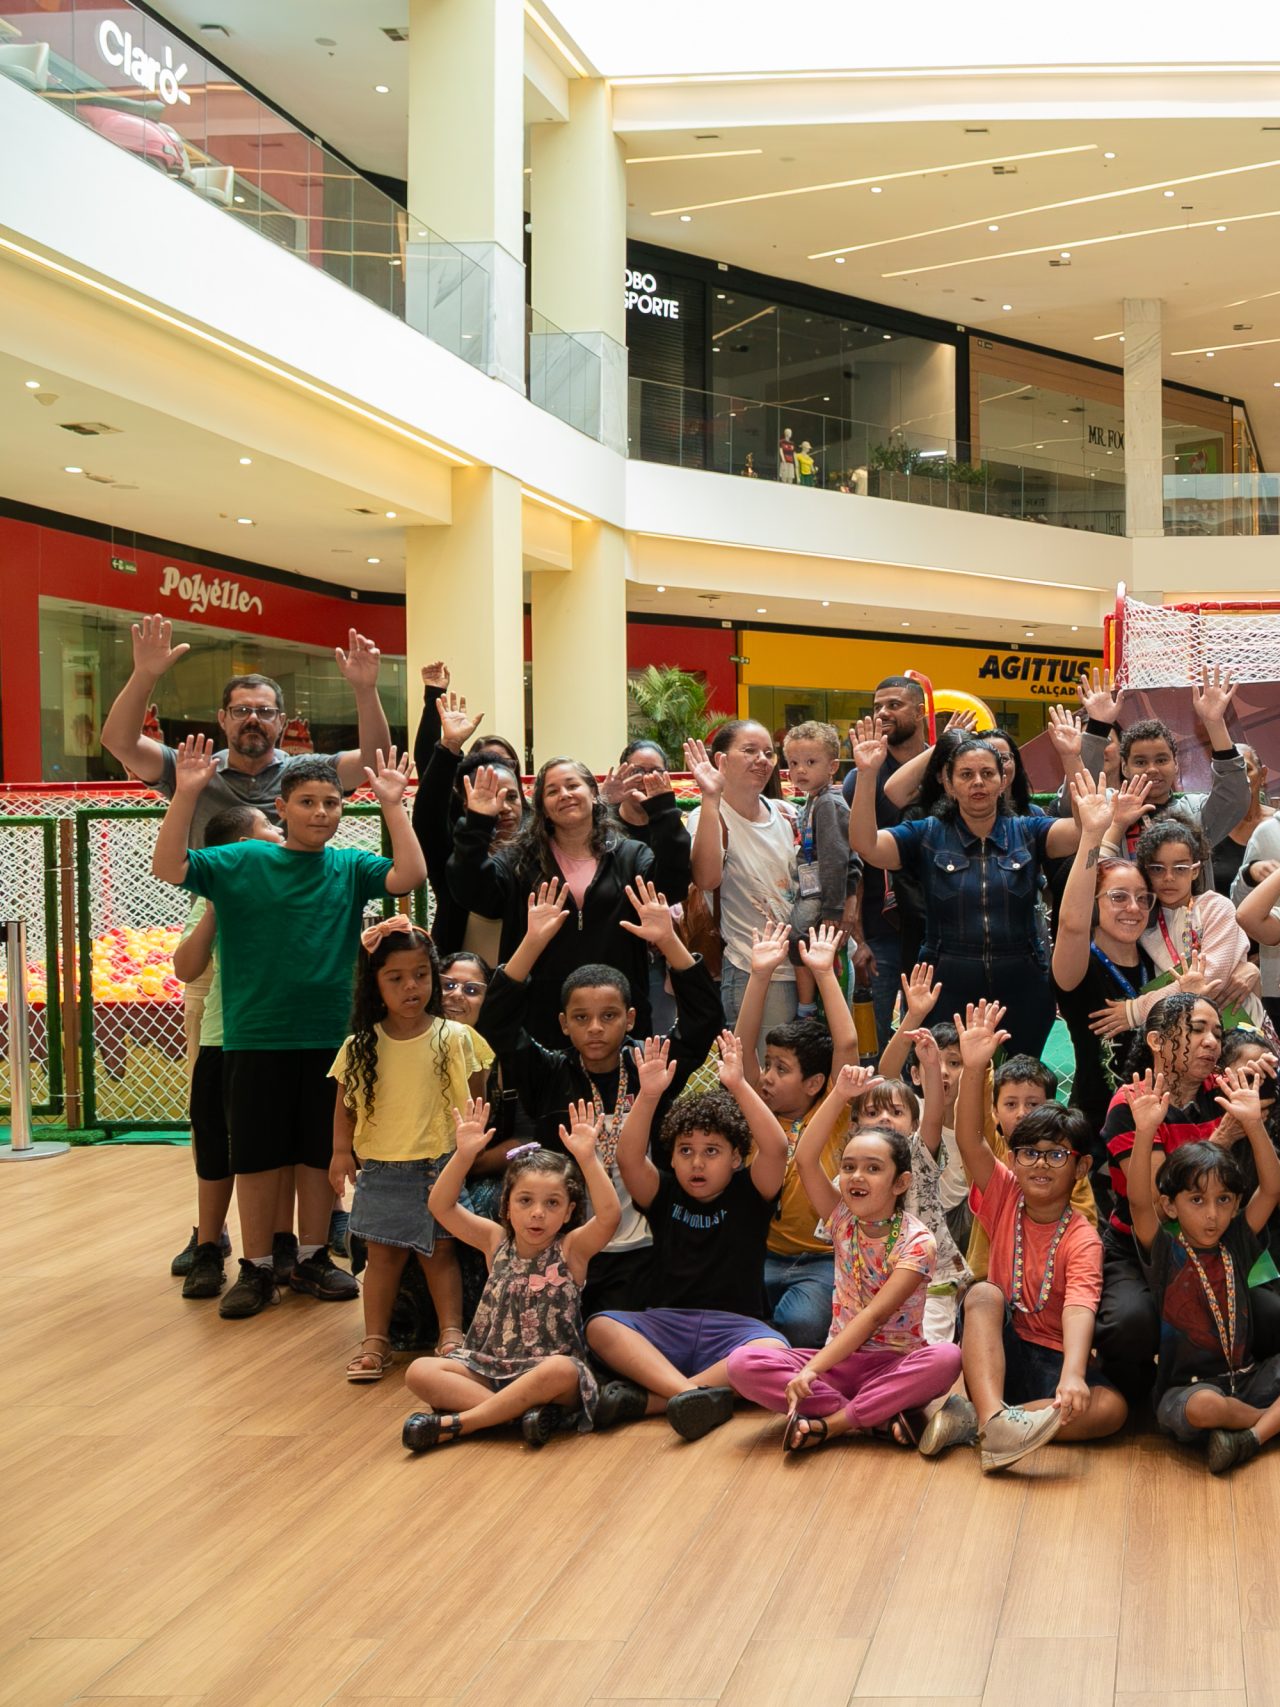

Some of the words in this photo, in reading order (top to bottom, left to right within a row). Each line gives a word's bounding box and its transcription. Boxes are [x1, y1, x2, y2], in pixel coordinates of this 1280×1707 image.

[99, 20, 186, 105] Claro
[979, 655, 1091, 684] AGITTUS
[1031, 685, 1085, 697] CALÇAD
